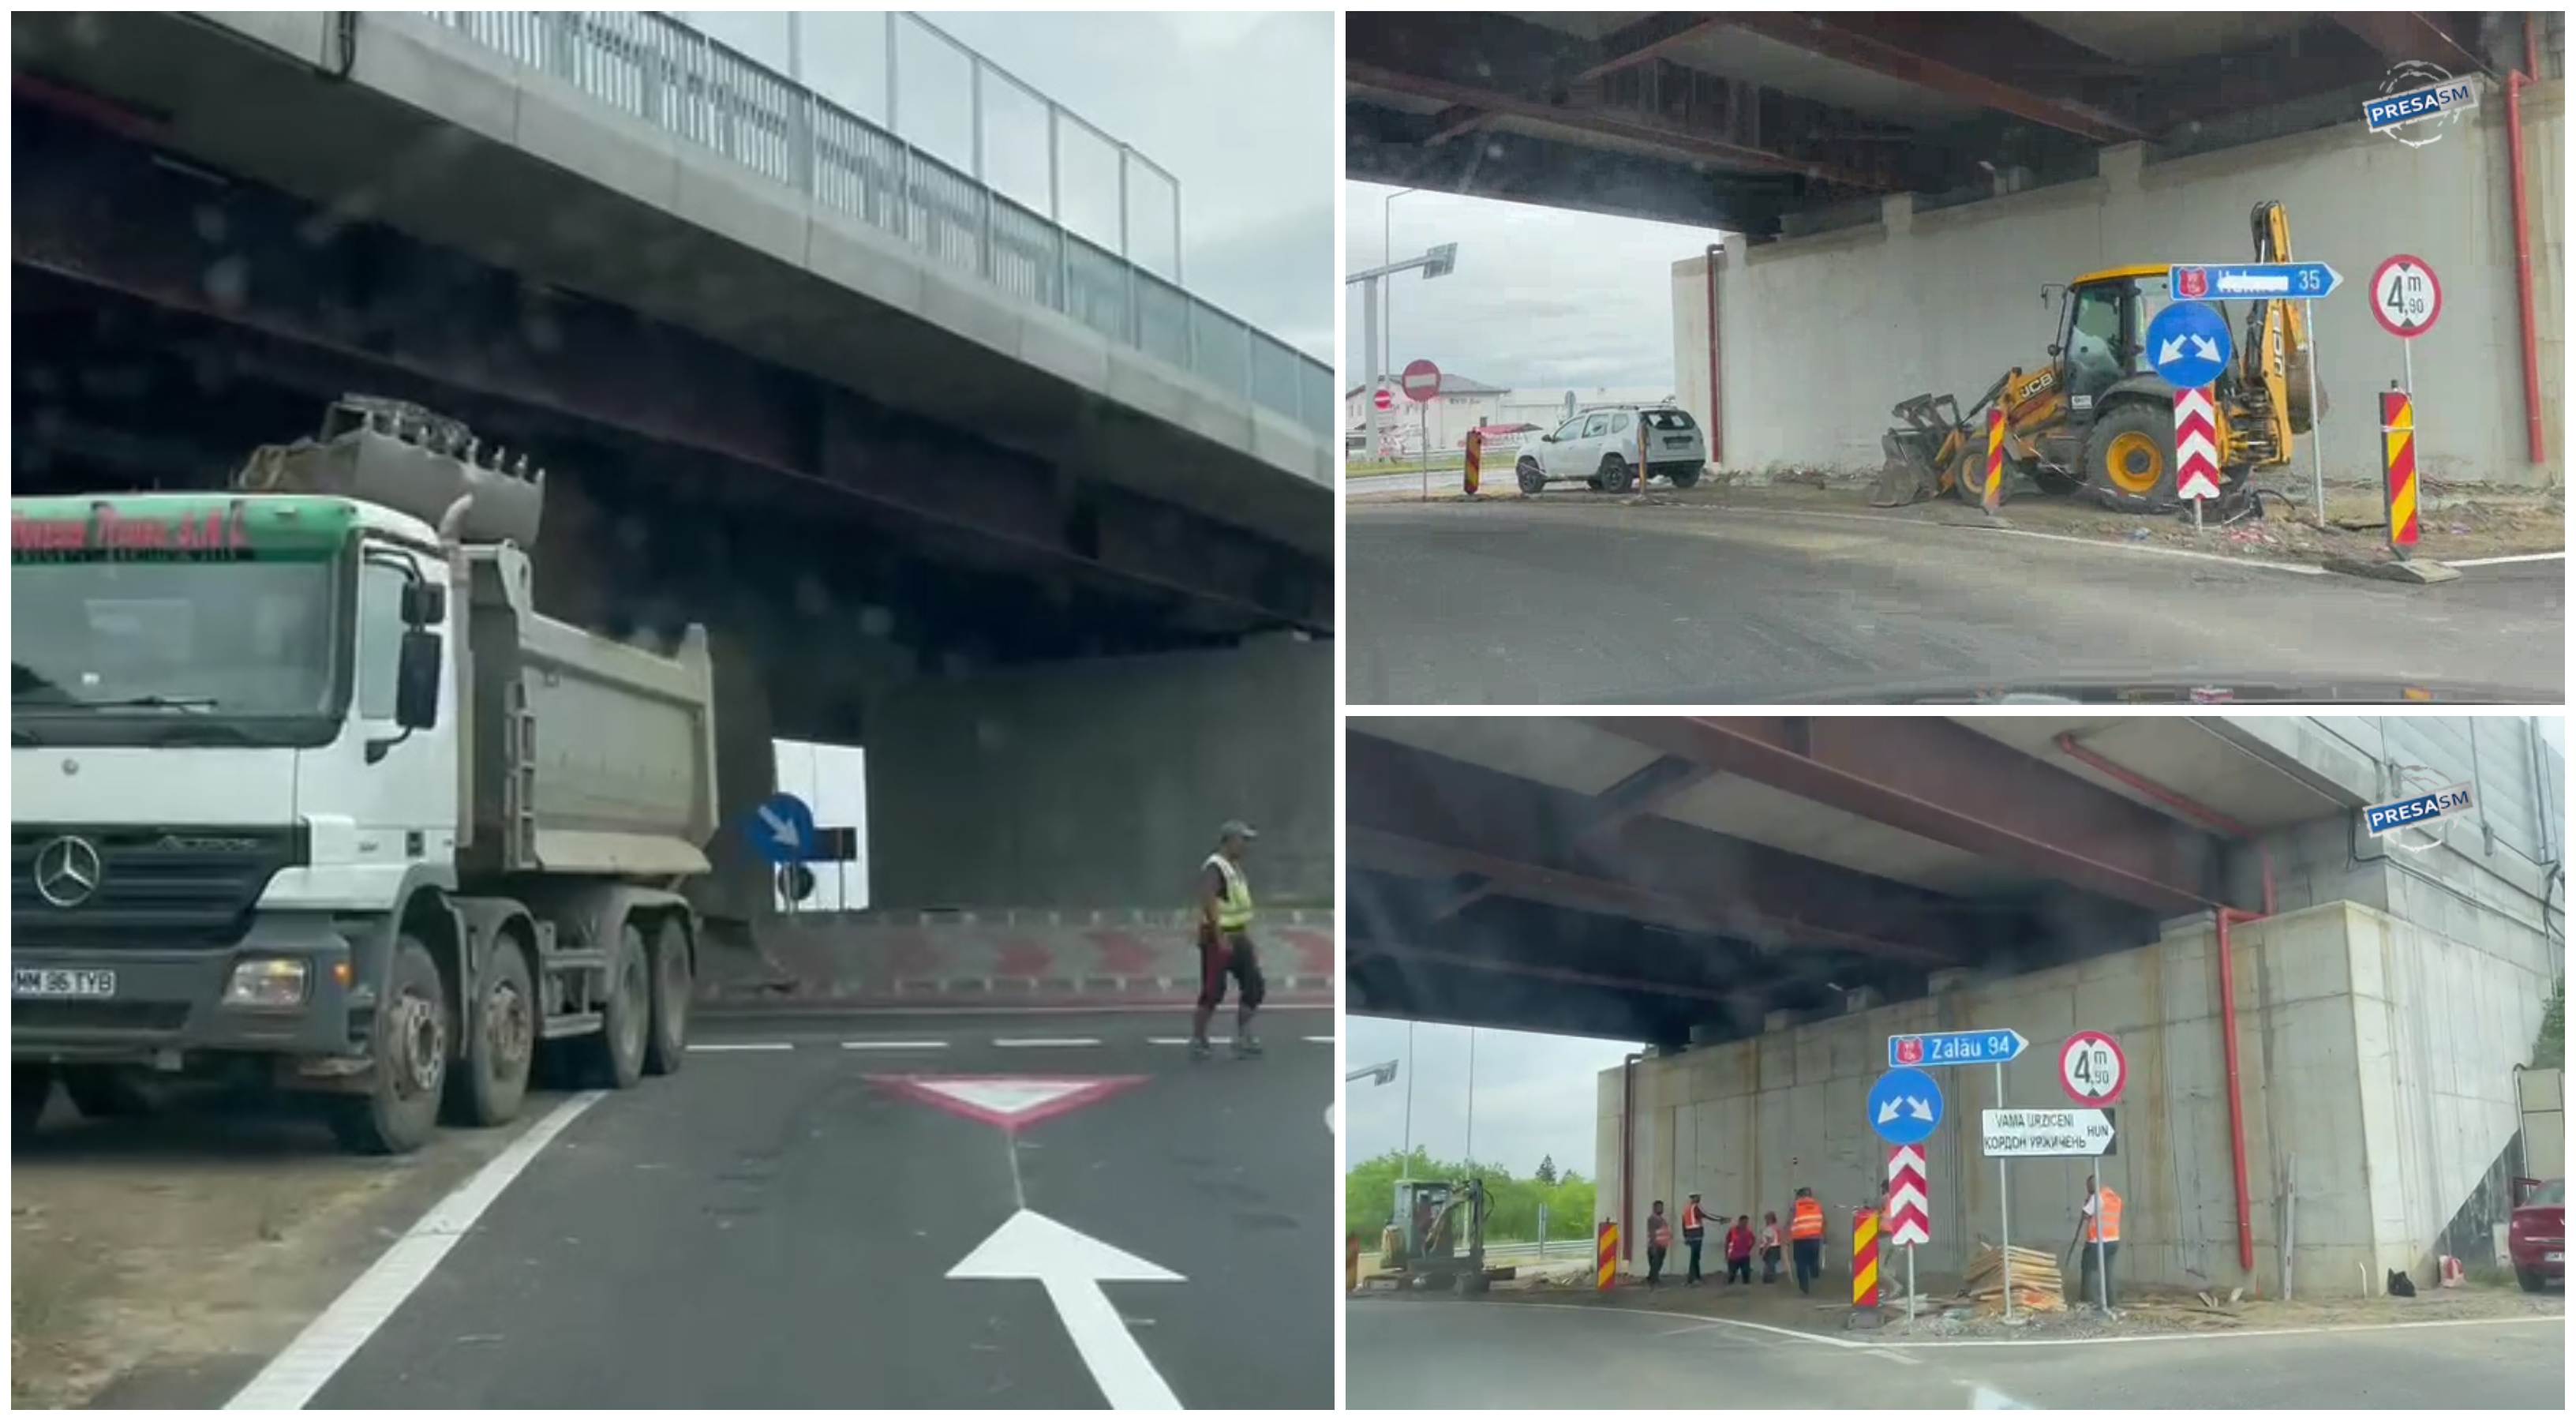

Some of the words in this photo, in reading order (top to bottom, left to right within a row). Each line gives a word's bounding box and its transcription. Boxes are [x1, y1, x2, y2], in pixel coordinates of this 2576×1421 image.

[2298, 270, 2320, 291] 35
[2021, 373, 2053, 397] JCB
[1987, 1036, 2009, 1055] 94
[1995, 1114, 2025, 1127] VAMA
[2087, 1125, 2109, 1137] HUN
